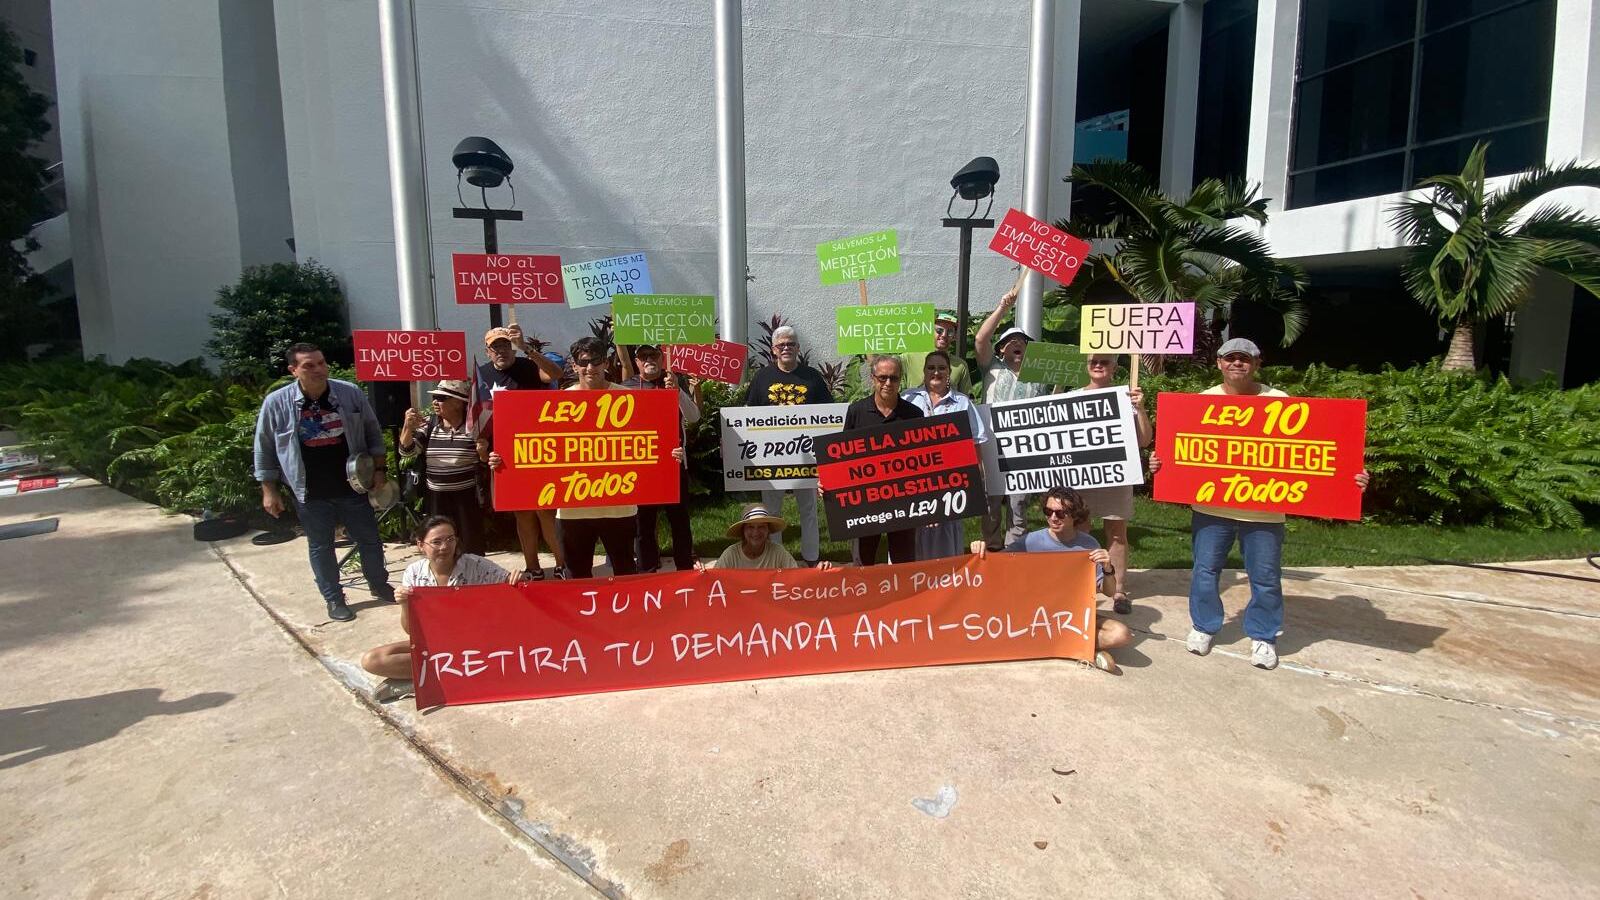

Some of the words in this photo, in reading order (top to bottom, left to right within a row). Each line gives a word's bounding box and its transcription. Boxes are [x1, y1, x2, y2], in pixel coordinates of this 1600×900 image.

[832, 236, 873, 251] SALVEMOS
[1029, 221, 1049, 236] NO
[1052, 234, 1068, 246] al
[1000, 225, 1078, 269] IMPUESTO
[487, 257, 510, 268] NO
[517, 257, 535, 268] al
[564, 265, 577, 274] NO
[579, 262, 591, 271] ME
[595, 257, 628, 269] QUITES
[631, 254, 644, 262] MI
[821, 246, 897, 271] MEDICIÓN
[1003, 242, 1019, 258] AL
[1031, 254, 1058, 277] SOL
[458, 272, 558, 286] IMPUESTO
[572, 268, 641, 290] TRABAJO
[842, 264, 877, 280] NETA
[474, 287, 496, 300] AL
[512, 287, 548, 300] SOL
[585, 283, 635, 301] SOLAR
[634, 298, 687, 306] SALVEMOS
[616, 311, 712, 326] MEDICIÓN
[856, 307, 906, 316] SALVEMOS
[1091, 306, 1184, 327] FUERA
[387, 333, 410, 344] NO
[419, 334, 438, 344] al
[644, 329, 687, 341] NETA
[840, 320, 932, 337] MEDICIÓN
[864, 338, 906, 351] NETA
[1089, 330, 1184, 350] JUNTA
[359, 349, 461, 362] IMPUESTO
[1023, 358, 1084, 373] MEDICI
[374, 364, 397, 376] AL
[412, 364, 449, 376] SOL
[671, 359, 687, 371] AL
[700, 364, 727, 380] SOL
[1043, 372, 1079, 384] NETA
[538, 400, 587, 422] LEY
[596, 393, 635, 429] 10
[727, 418, 742, 427] La
[746, 415, 807, 427] Medición
[810, 415, 843, 424] Neta
[998, 402, 1068, 428] MEDICIÓN
[1072, 399, 1113, 420] NETA
[1201, 404, 1254, 426] LEY
[1263, 401, 1310, 435] 10
[514, 438, 556, 464] NOS
[565, 435, 659, 462] PROTEGE
[828, 438, 866, 458] QUE
[870, 434, 895, 451] LA
[900, 423, 959, 445] JUNTA
[997, 424, 1124, 455] PROTEGE
[738, 440, 757, 460] te
[1050, 456, 1055, 465] A
[1057, 455, 1072, 464] LAS
[1175, 437, 1218, 463] NOS
[1228, 440, 1337, 471] PROTEGE
[727, 469, 743, 478] de
[746, 468, 772, 479] LOS
[849, 463, 875, 480] NO
[881, 452, 943, 474] TOQUE
[1006, 464, 1124, 491] COMUNIDADES
[538, 483, 556, 506] a
[836, 490, 861, 507] TU
[866, 473, 969, 502] BOLSILLO;
[1196, 481, 1215, 503] a
[846, 512, 892, 528] protege
[895, 509, 905, 519] la
[909, 499, 937, 517] LEY
[942, 490, 967, 516] 10
[579, 580, 727, 615] JUNTA
[772, 577, 867, 601] Escucha
[880, 574, 898, 593] al
[911, 567, 983, 591] Pueblo
[419, 639, 587, 687] ¡RETIRA
[604, 641, 654, 668] TU
[671, 617, 837, 662] DEMANDA
[854, 606, 1092, 650] ANTI-SOLAR!
